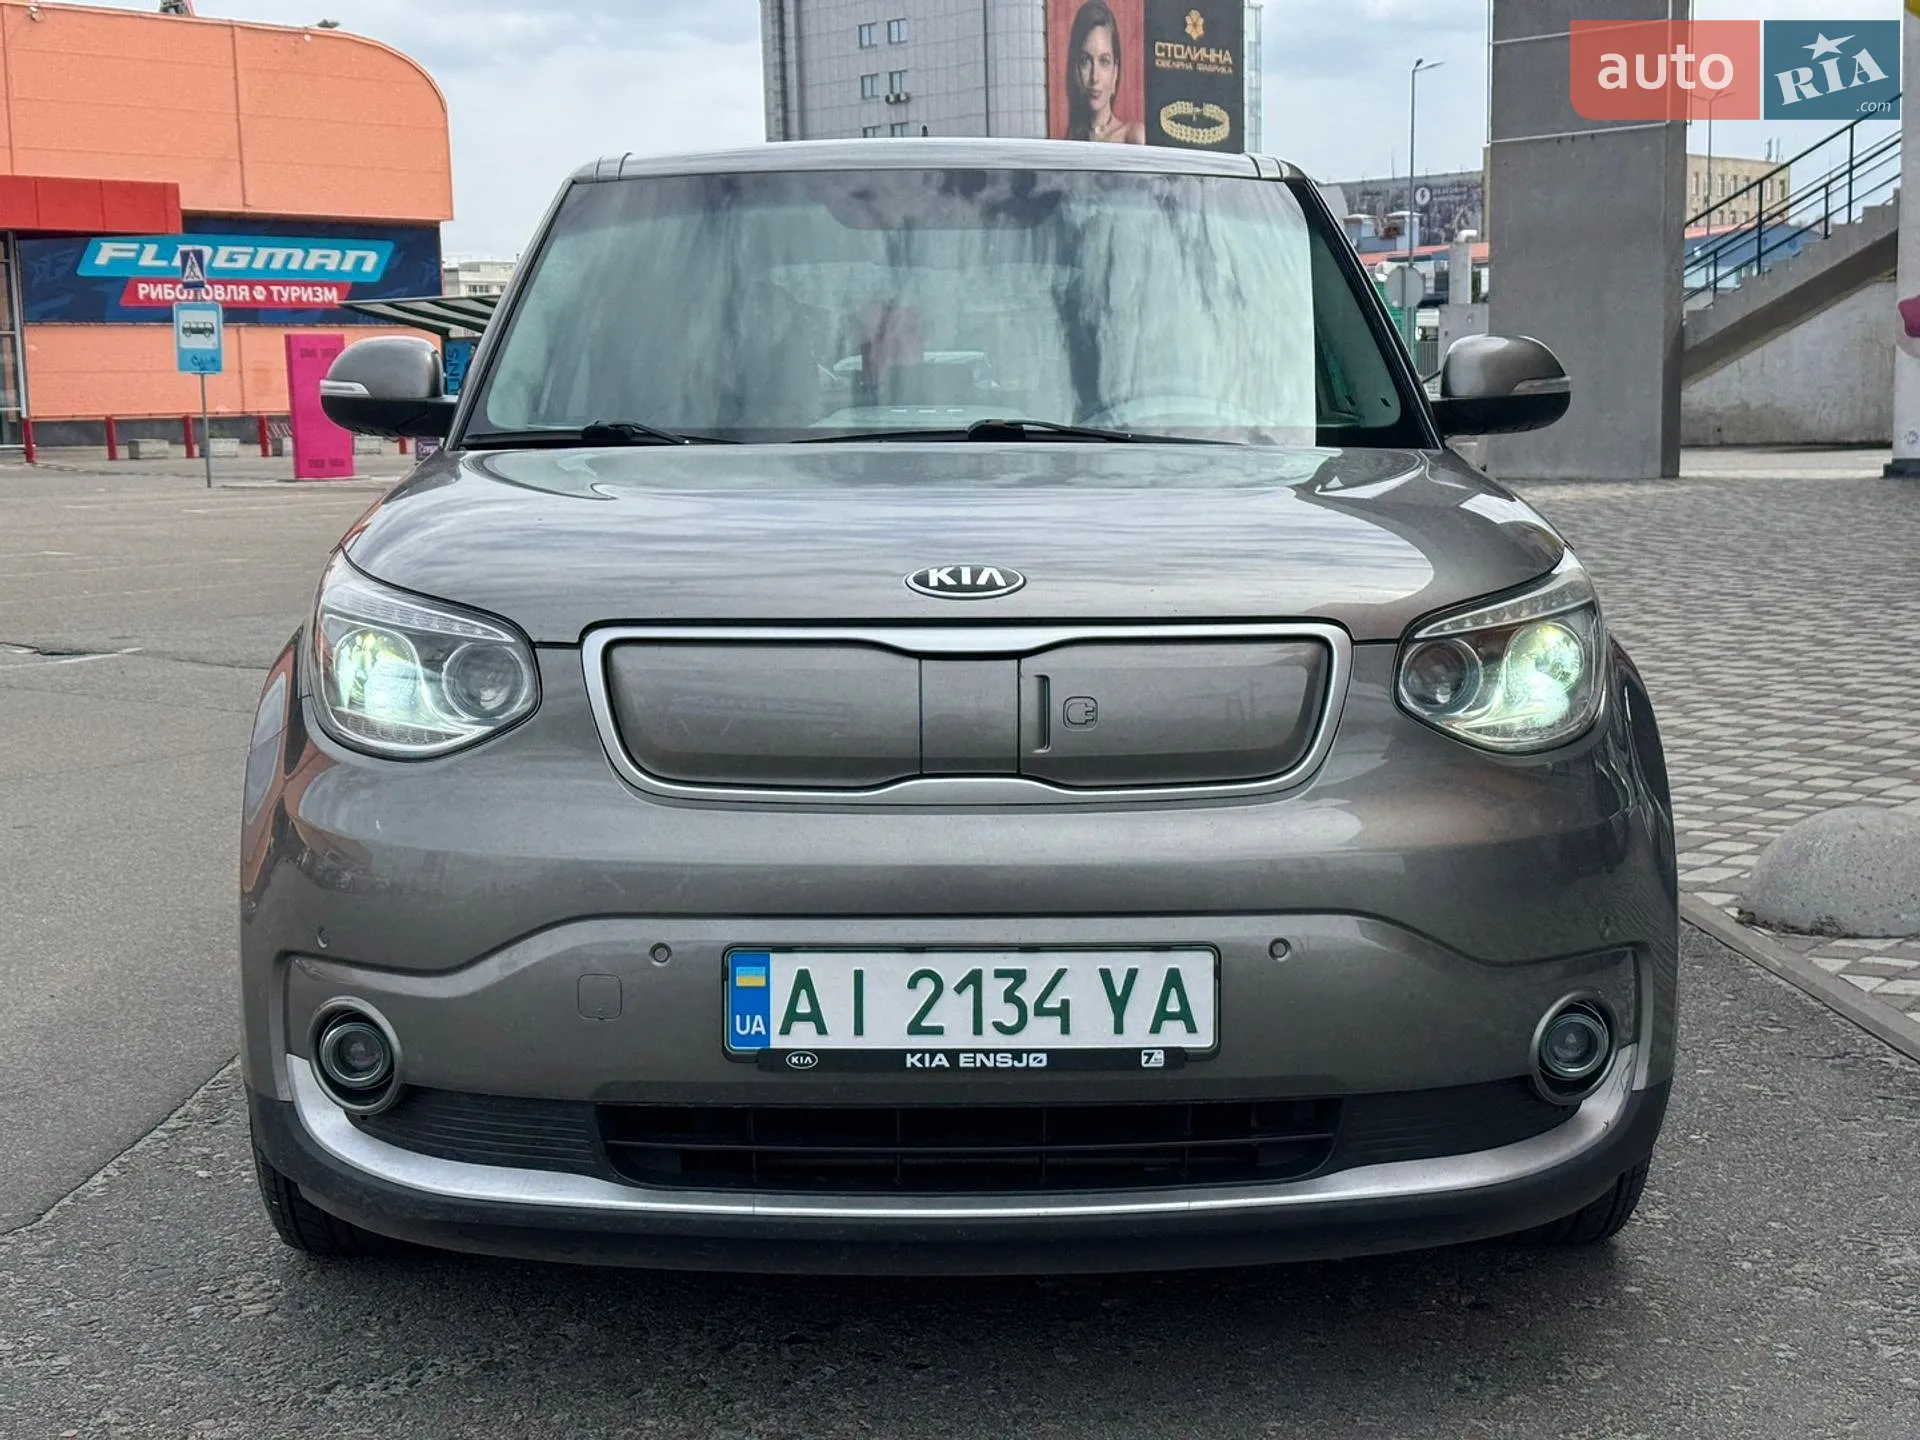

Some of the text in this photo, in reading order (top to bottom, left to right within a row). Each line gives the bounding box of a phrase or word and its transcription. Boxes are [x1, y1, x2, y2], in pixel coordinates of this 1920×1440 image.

[1154, 41, 1233, 65] СТОЛИЧНА
[269, 284, 338, 303] ТУРИЗМ
[928, 565, 1007, 587] KIA
[778, 966, 1198, 1037] AI 2134 YA
[735, 1014, 766, 1036] UA
[790, 1055, 812, 1065] KIA
[905, 1053, 950, 1068] KIA
